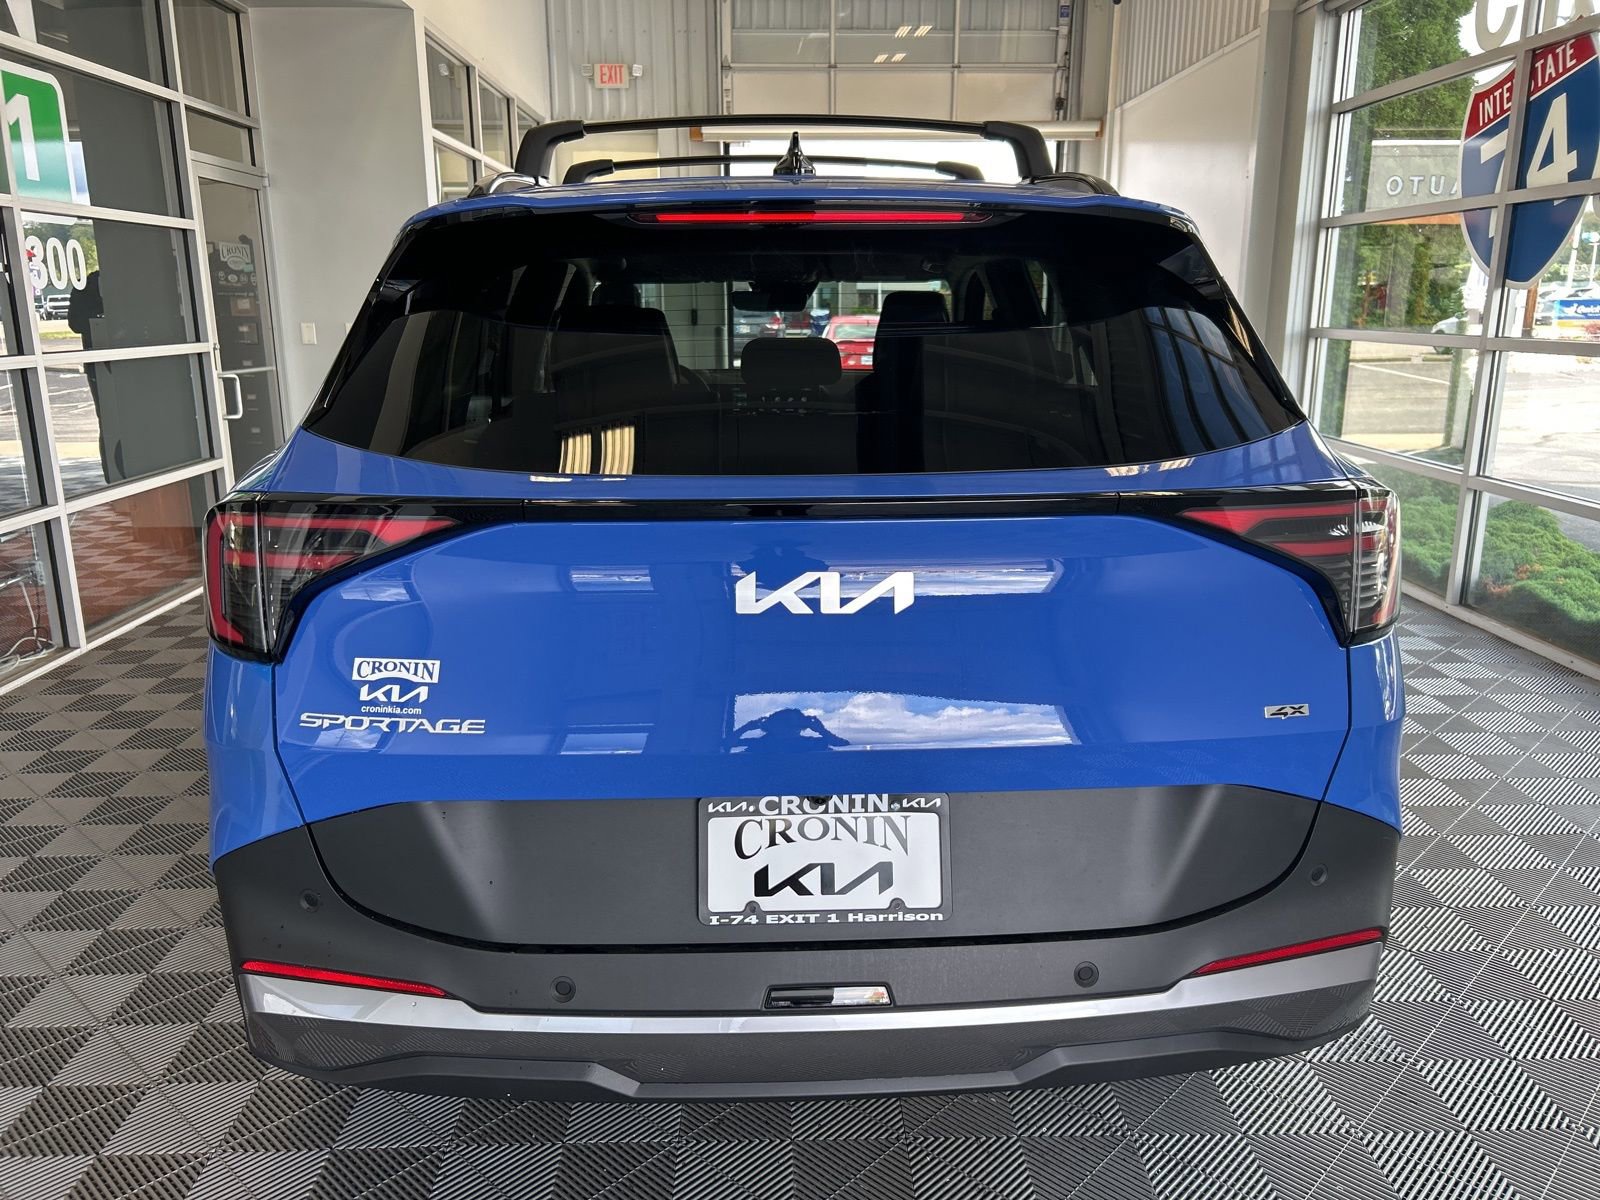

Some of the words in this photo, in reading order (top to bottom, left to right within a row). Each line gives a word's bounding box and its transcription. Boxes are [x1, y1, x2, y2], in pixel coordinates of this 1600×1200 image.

[600, 64, 624, 84] EXIT
[1479, 39, 1577, 127] INTETATE
[735, 571, 914, 615] KIA
[356, 660, 436, 681] CRONIN
[359, 684, 429, 703] KIA
[361, 705, 422, 715] croninkia.com
[299, 712, 486, 734] SPORTAGE
[708, 801, 748, 813] KIA
[758, 793, 889, 815] CRONIN
[903, 797, 942, 809] KIA
[734, 815, 912, 860] CRONIN
[754, 861, 894, 898] KIA
[709, 915, 759, 926] I-74
[766, 914, 820, 924] EXIT
[828, 914, 840, 923] 1
[848, 911, 944, 923] Harrison
